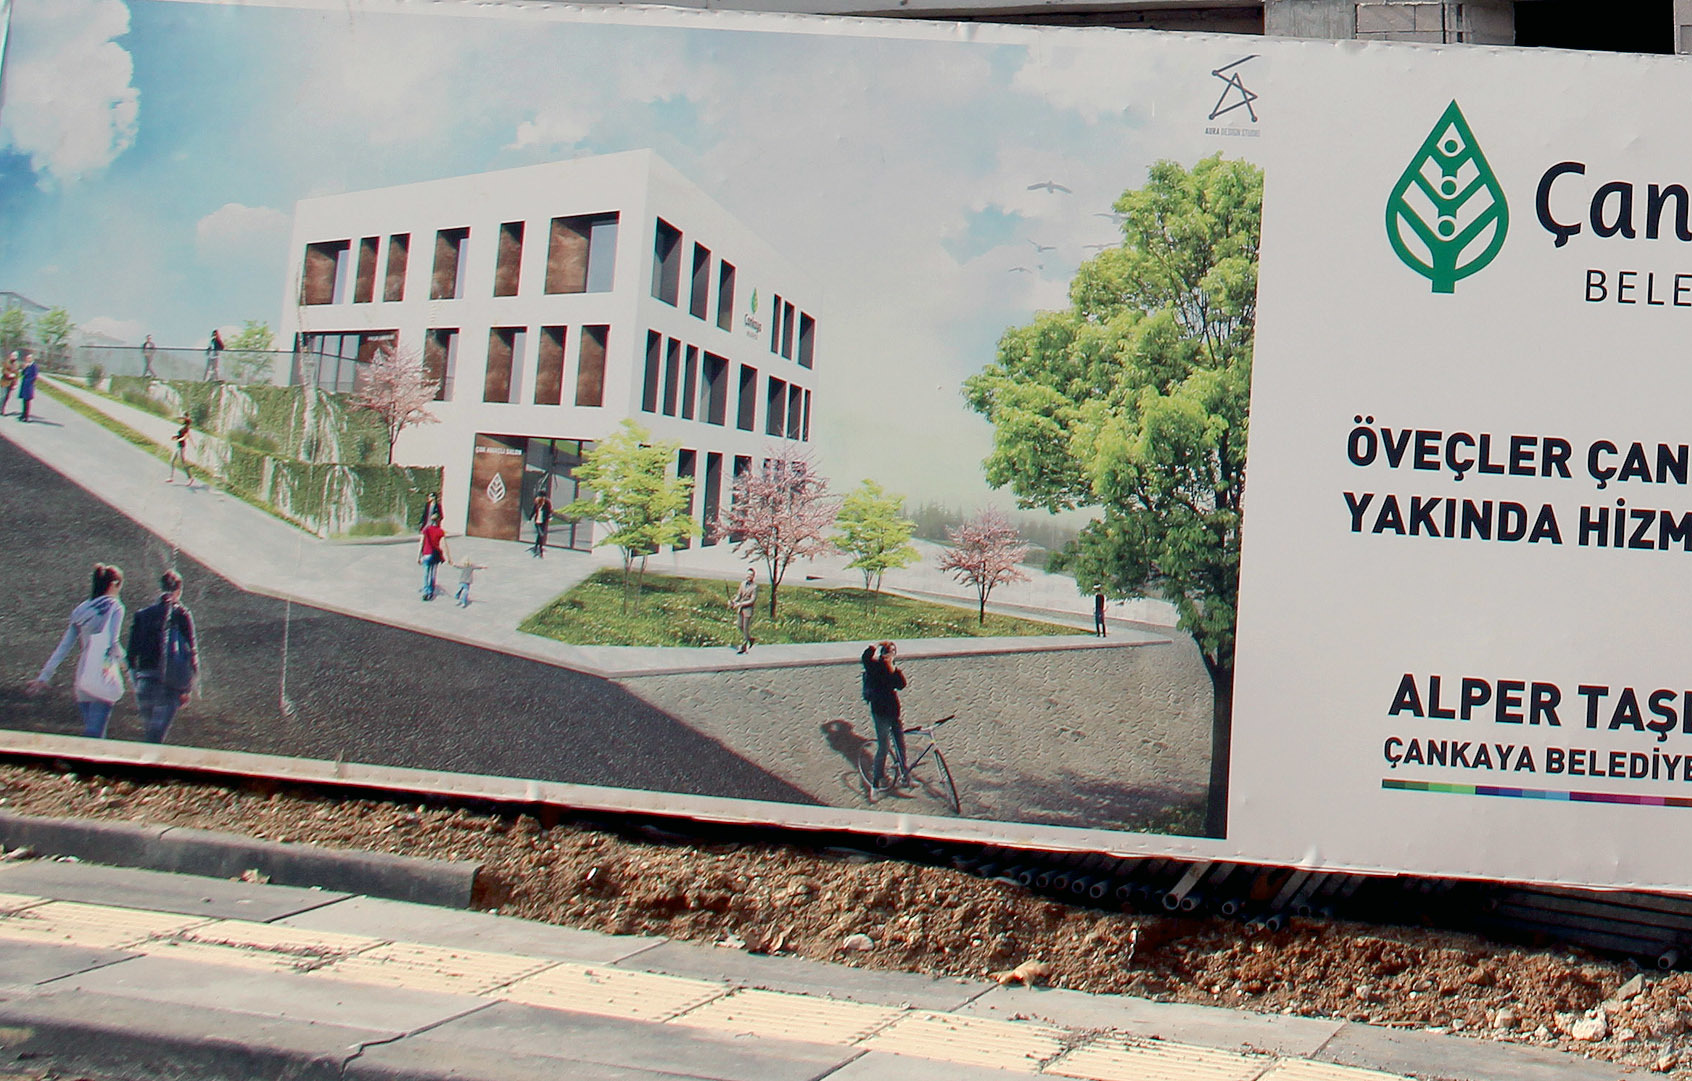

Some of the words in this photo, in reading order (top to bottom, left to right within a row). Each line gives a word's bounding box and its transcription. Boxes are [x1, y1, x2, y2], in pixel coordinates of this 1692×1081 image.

[1347, 415, 1573, 482] ÖVEÇLER
[1342, 491, 1563, 545] YAKINDA
[1387, 673, 1562, 727] ALPER
[1384, 736, 1536, 773] ÇANKAYA
